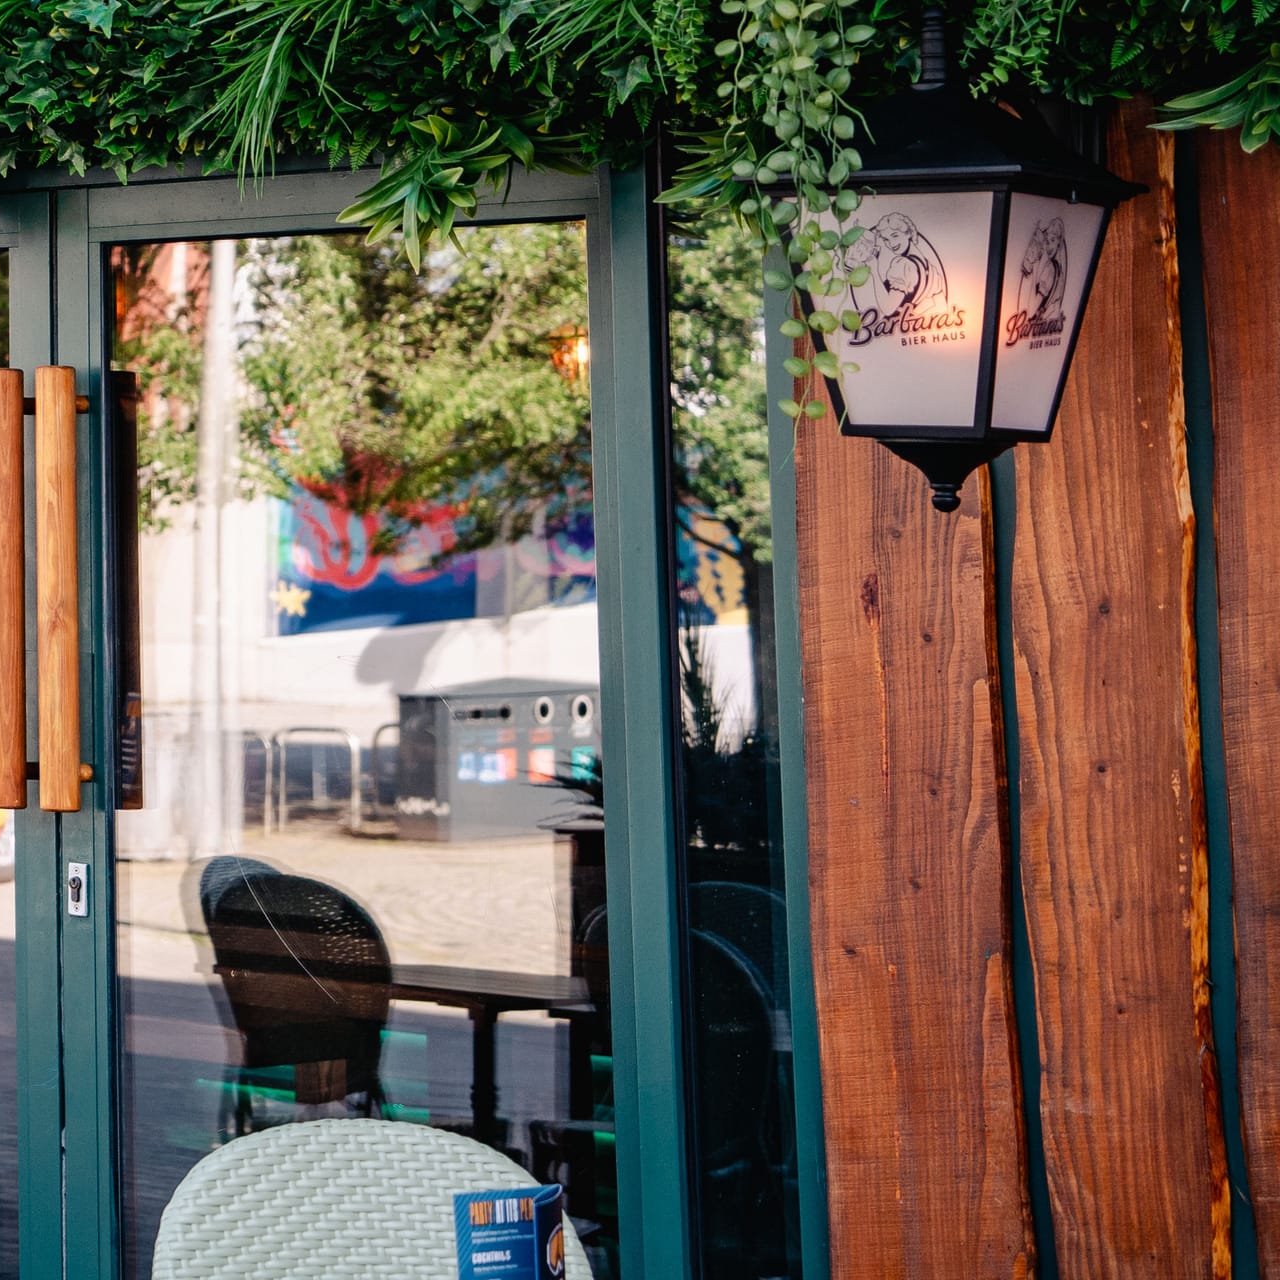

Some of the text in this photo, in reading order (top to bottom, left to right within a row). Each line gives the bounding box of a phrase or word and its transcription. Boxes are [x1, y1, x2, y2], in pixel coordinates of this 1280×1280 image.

[842, 303, 966, 346] Barbara's
[1006, 306, 1066, 347] Barbara's
[901, 330, 966, 347] BIER HAUS
[1029, 337, 1061, 350] BIER HAUS
[470, 1202, 493, 1225] PARTY
